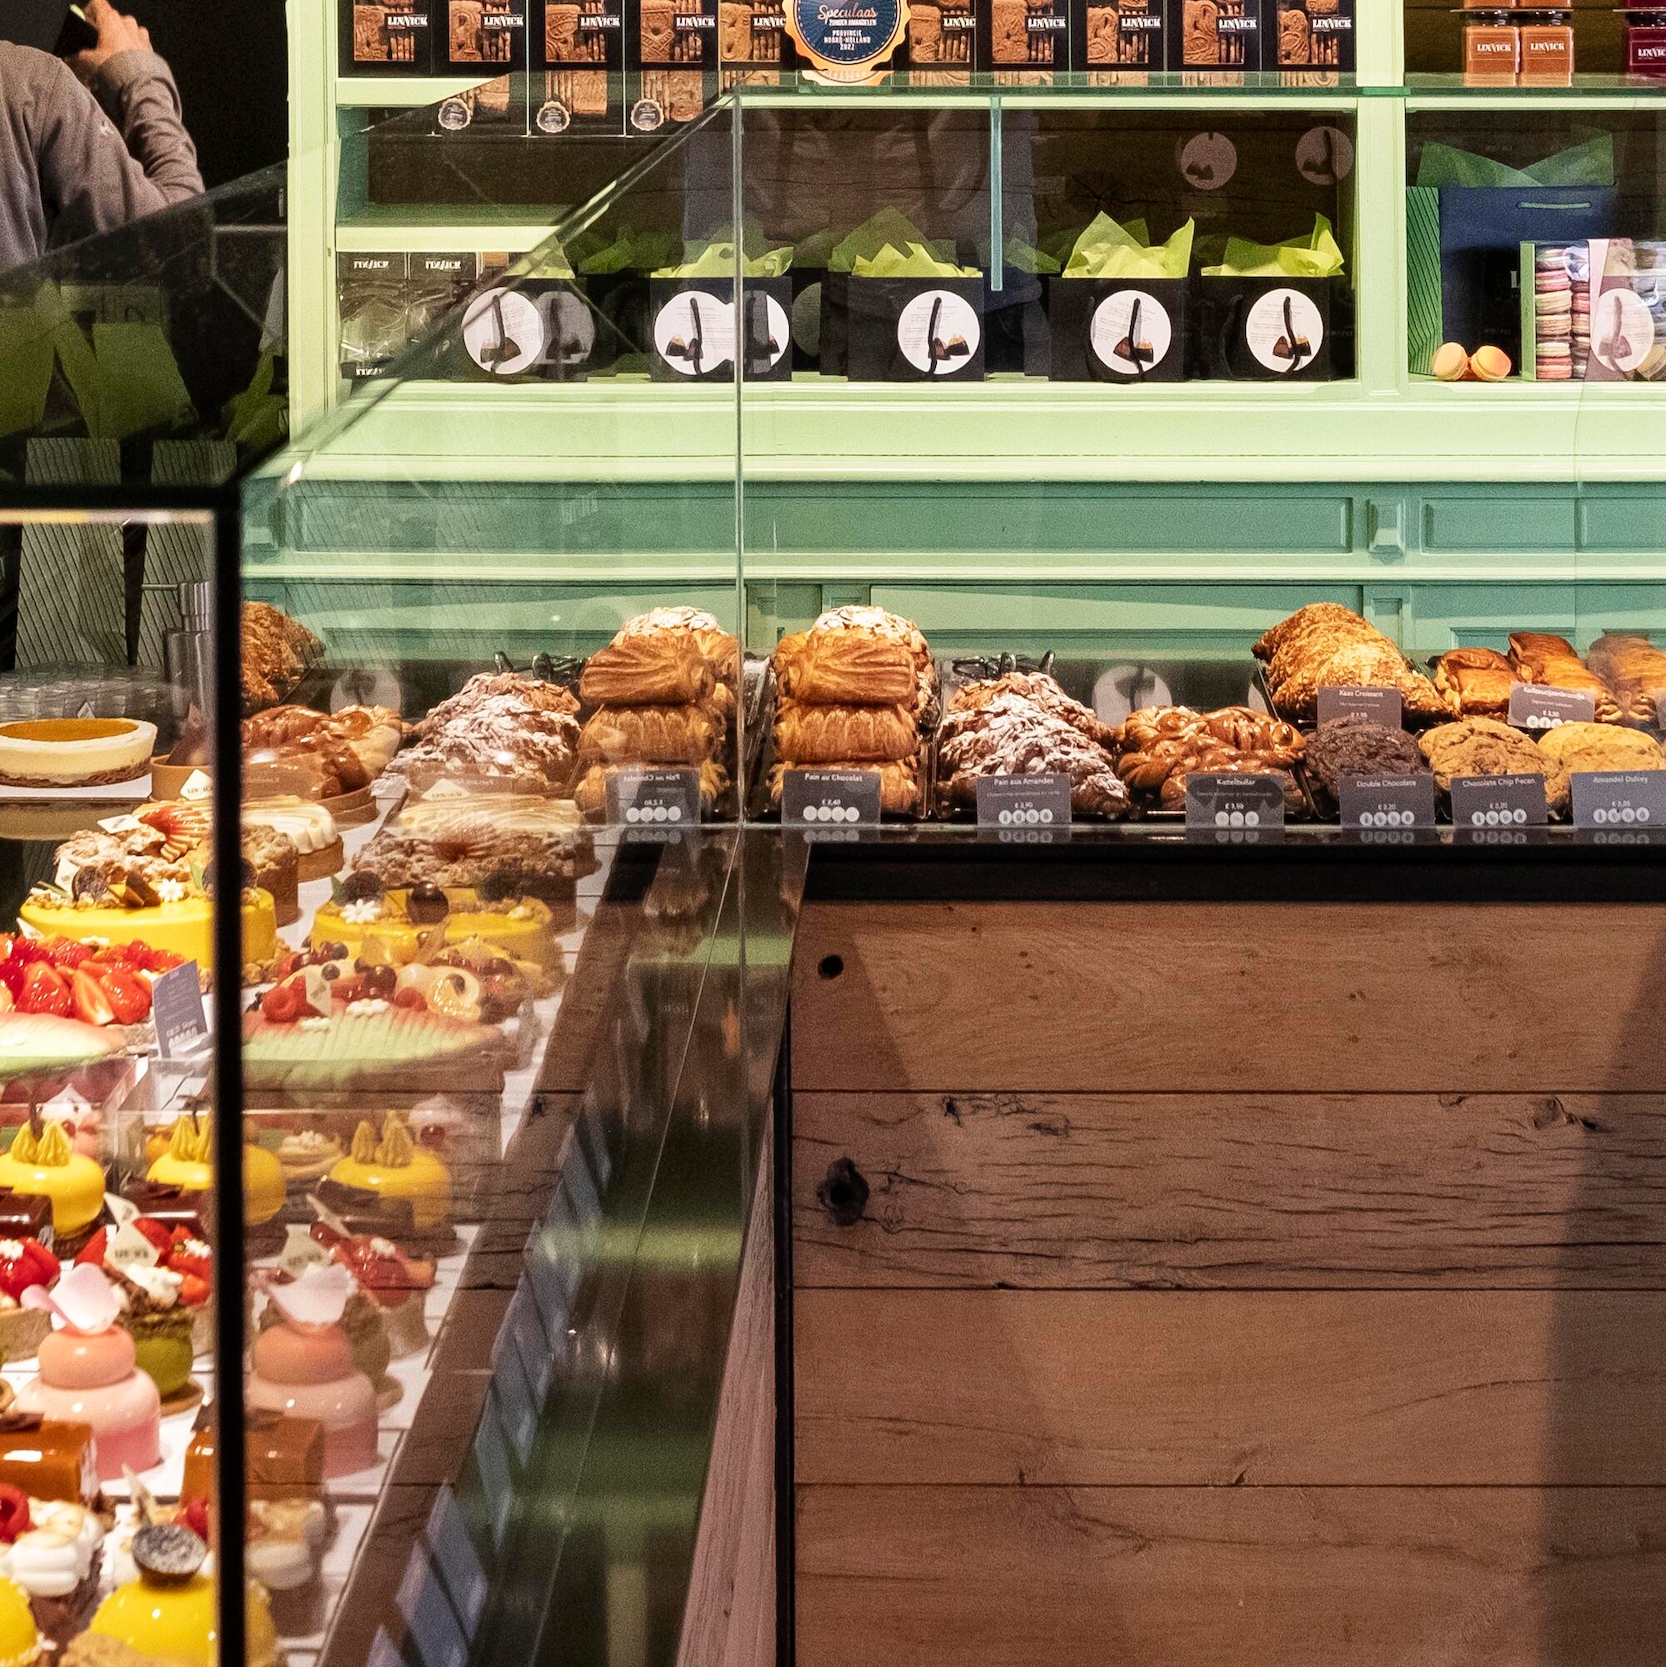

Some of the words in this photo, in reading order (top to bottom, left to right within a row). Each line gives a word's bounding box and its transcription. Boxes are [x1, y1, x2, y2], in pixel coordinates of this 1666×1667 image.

[817, 5, 878, 24] Speculaas
[804, 772, 820, 781] Pain
[831, 773, 863, 782] Chocolat
[1382, 779, 1417, 787] Chocolate
[1462, 779, 1497, 787] Chocolate
[1498, 778, 1514, 787] Chip
